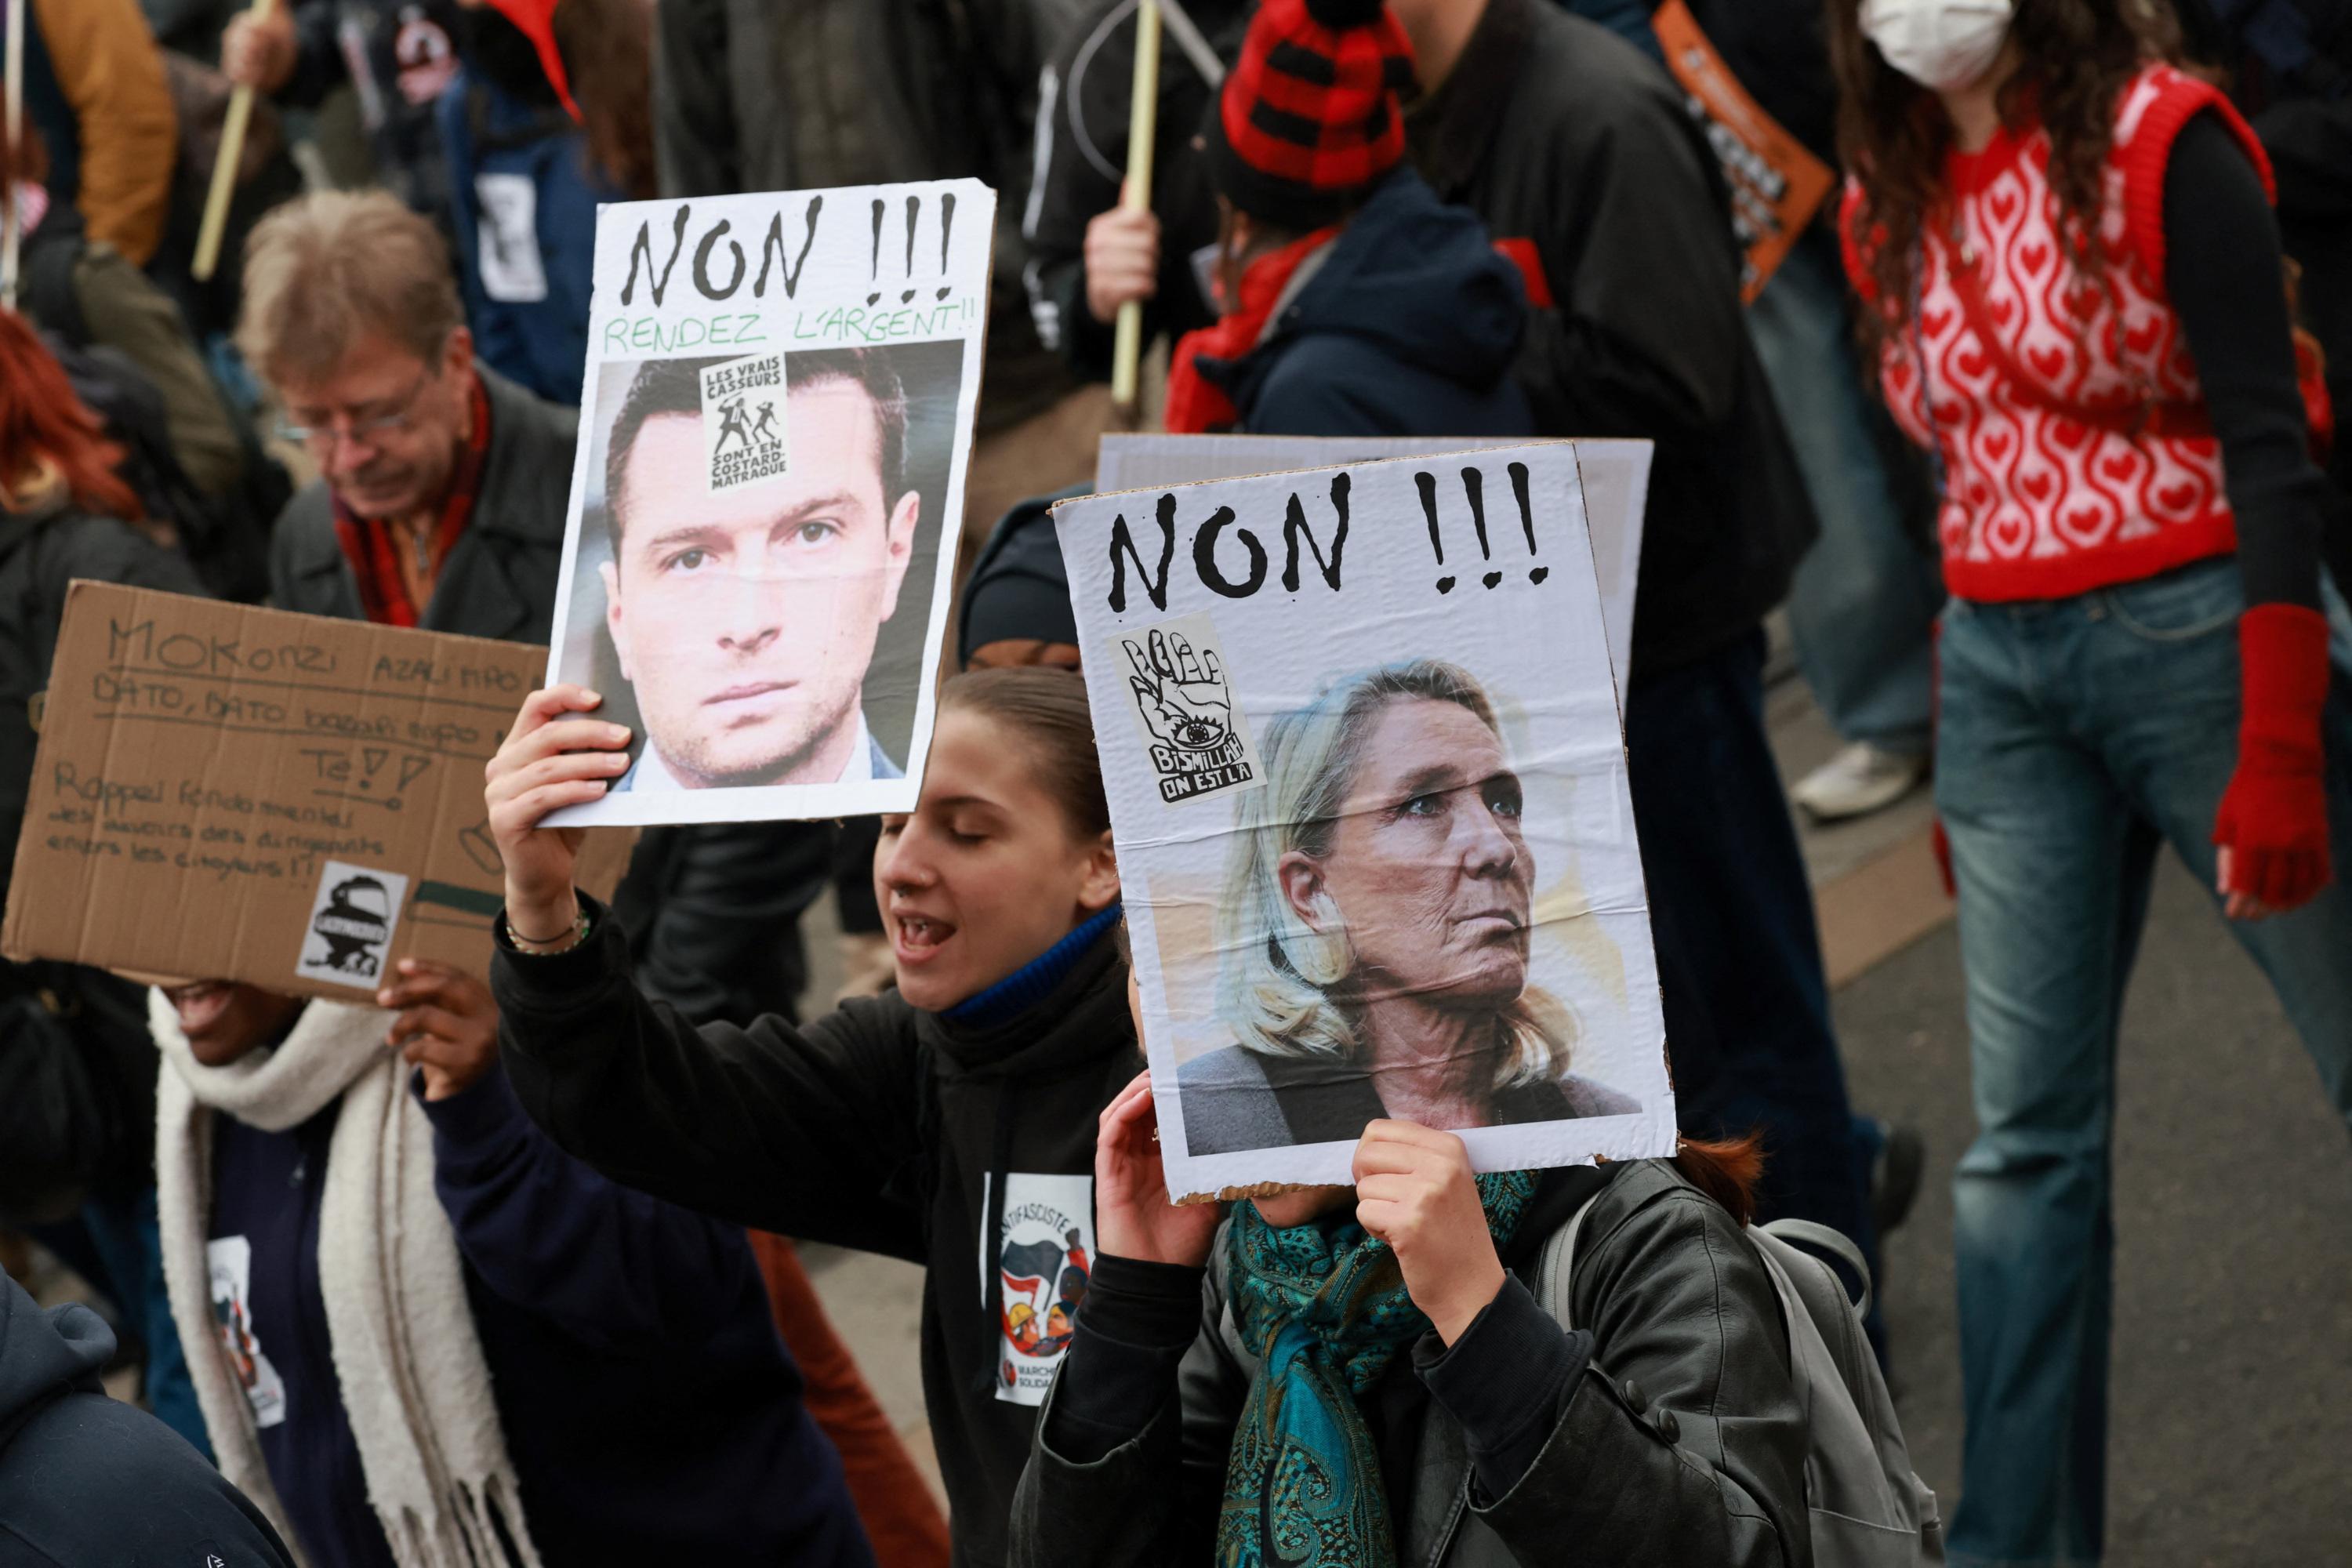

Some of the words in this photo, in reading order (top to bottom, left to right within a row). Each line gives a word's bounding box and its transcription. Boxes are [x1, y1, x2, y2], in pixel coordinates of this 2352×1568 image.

[621, 195, 822, 307] NON
[866, 193, 956, 307] !!!
[604, 314, 767, 354] RENDEZ
[707, 368, 733, 387] LES
[738, 356, 779, 376] VRAIS
[707, 370, 781, 400] CASSEURS
[713, 445, 754, 466] SONT
[760, 438, 782, 454] EN
[712, 460, 786, 490] MATRAQUE
[1108, 472, 1351, 613] NON
[1414, 462, 1549, 594] !!!
[1163, 776, 1192, 799] ON
[1193, 769, 1223, 790] EST
